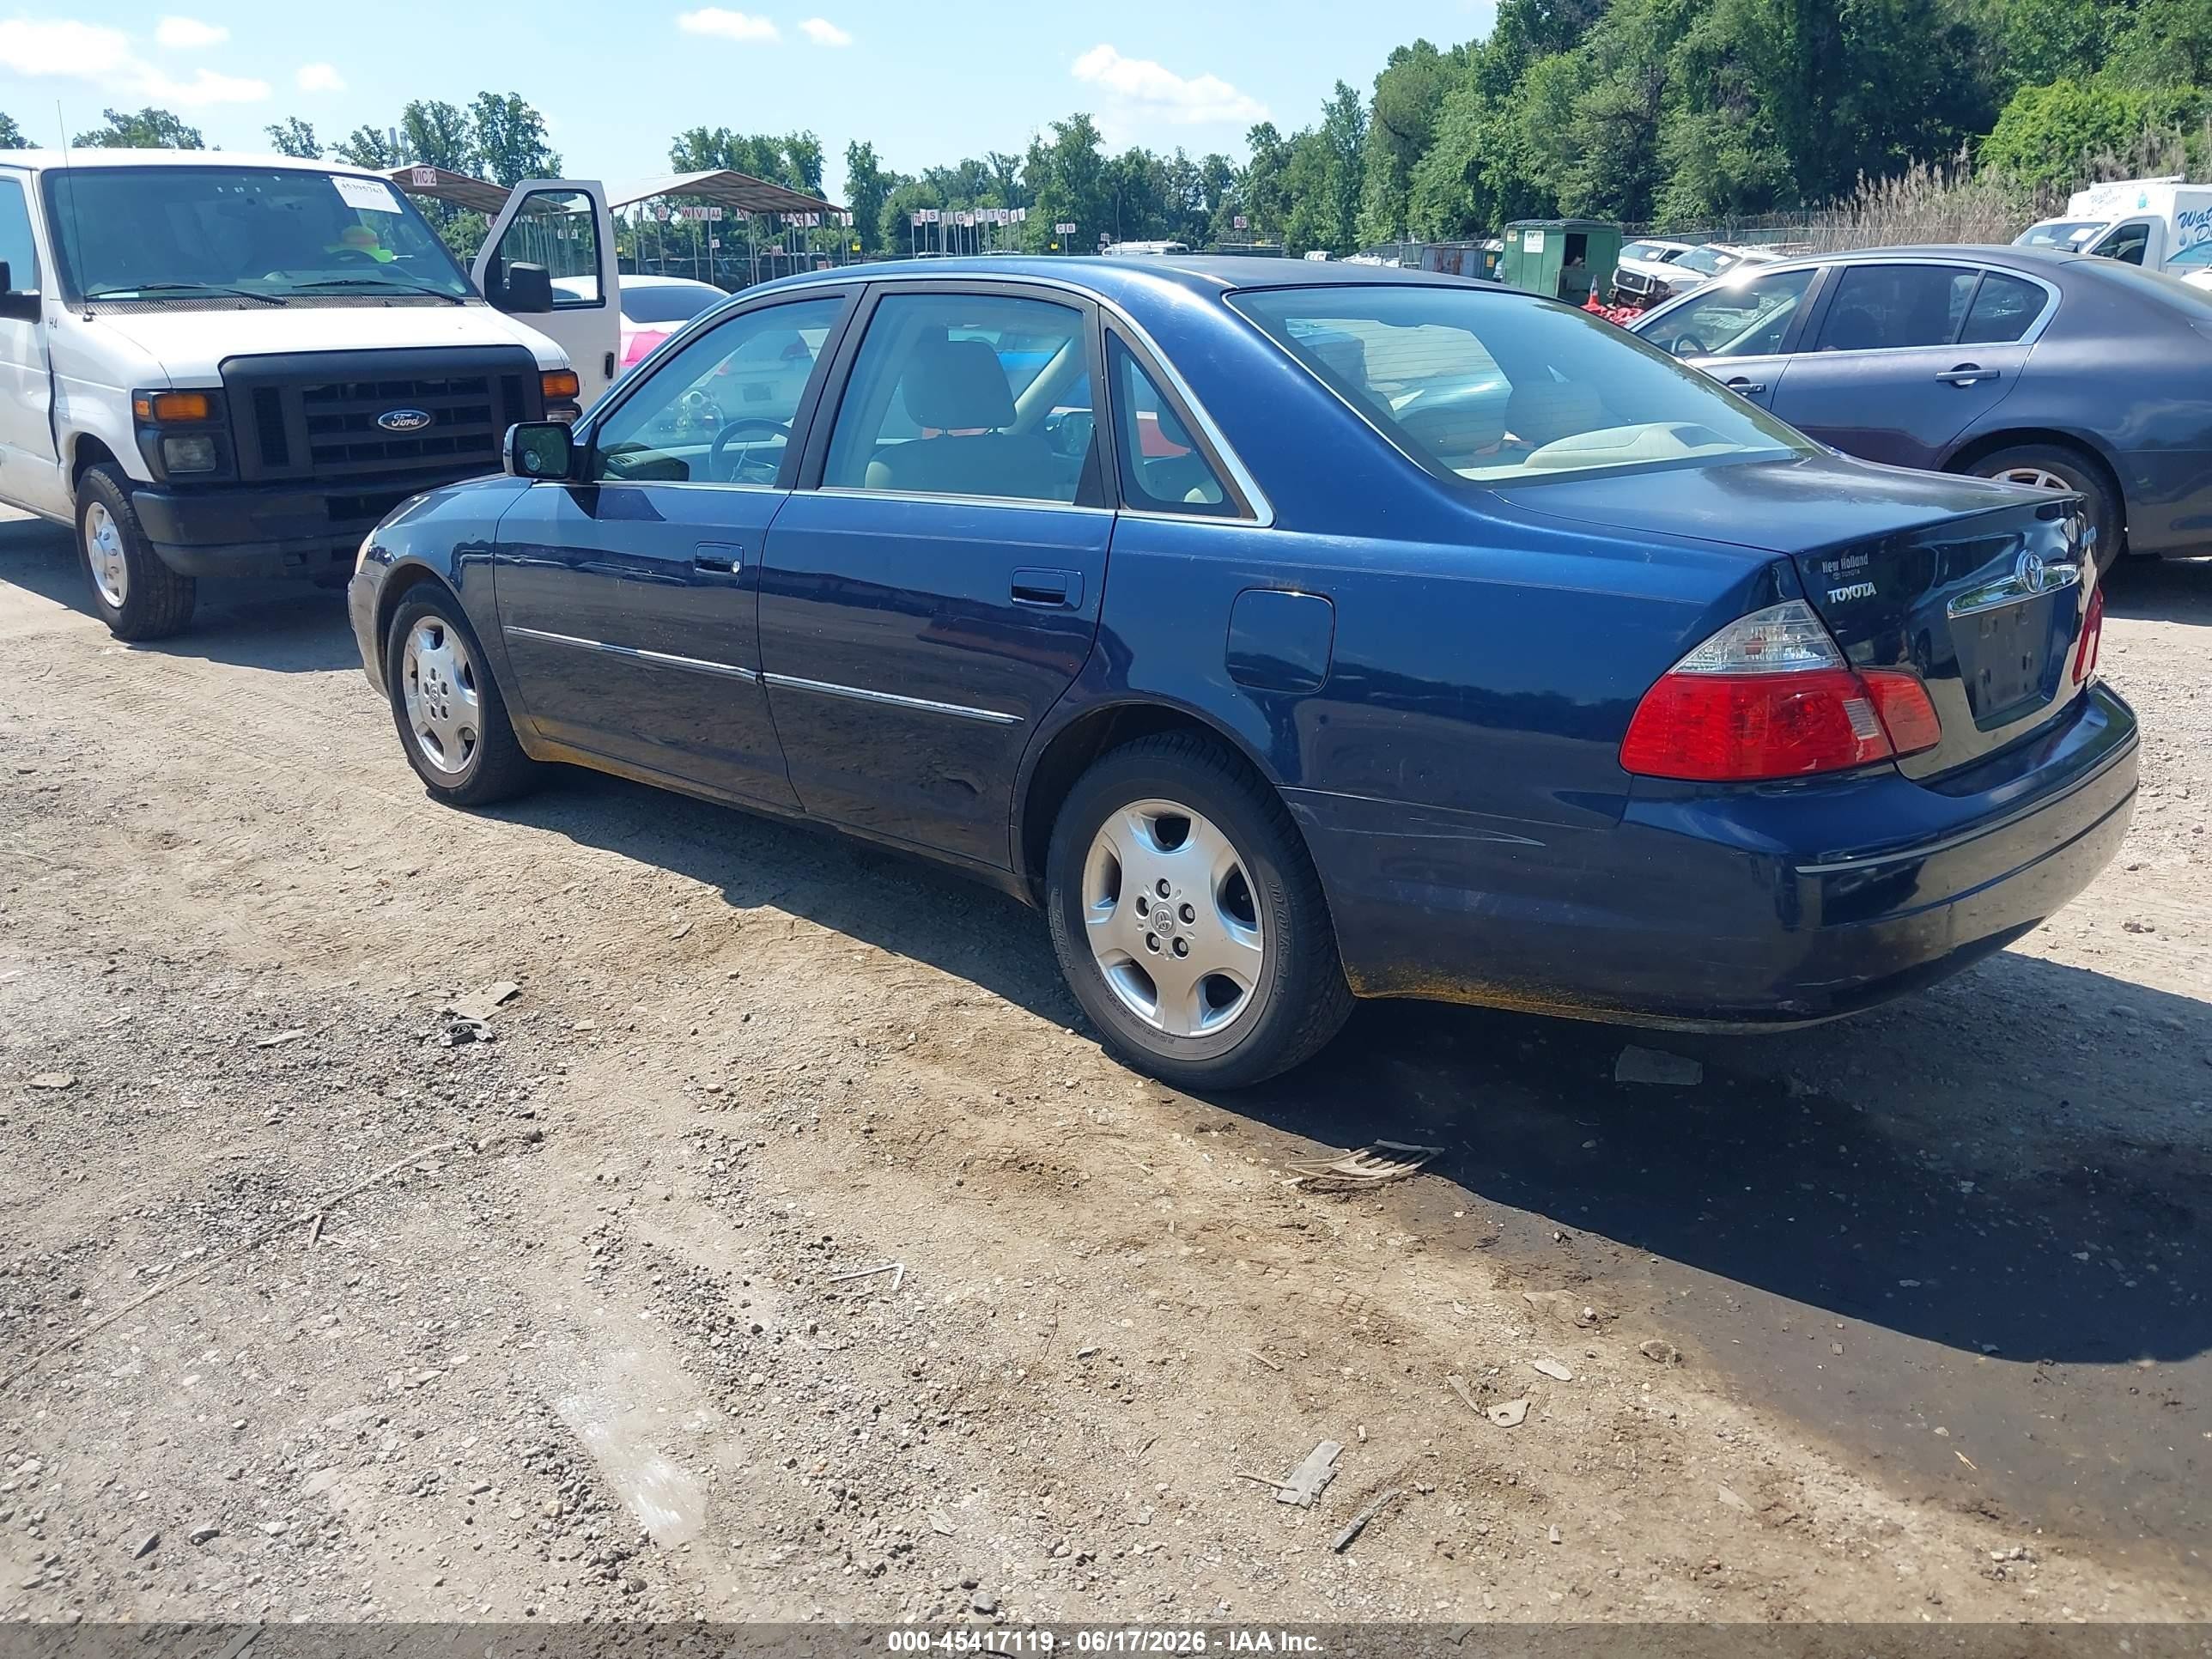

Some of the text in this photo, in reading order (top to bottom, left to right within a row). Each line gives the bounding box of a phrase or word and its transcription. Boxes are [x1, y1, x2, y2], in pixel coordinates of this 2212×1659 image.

[412, 170, 436, 184] VIC 2
[681, 210, 690, 218] W
[696, 209, 702, 218] V
[711, 210, 720, 218] AA
[989, 210, 996, 219] T
[48, 316, 58, 330] H4
[391, 413, 420, 427] Ford
[1822, 552, 1869, 574] New Holland
[1826, 581, 1877, 604] TOYOTA
